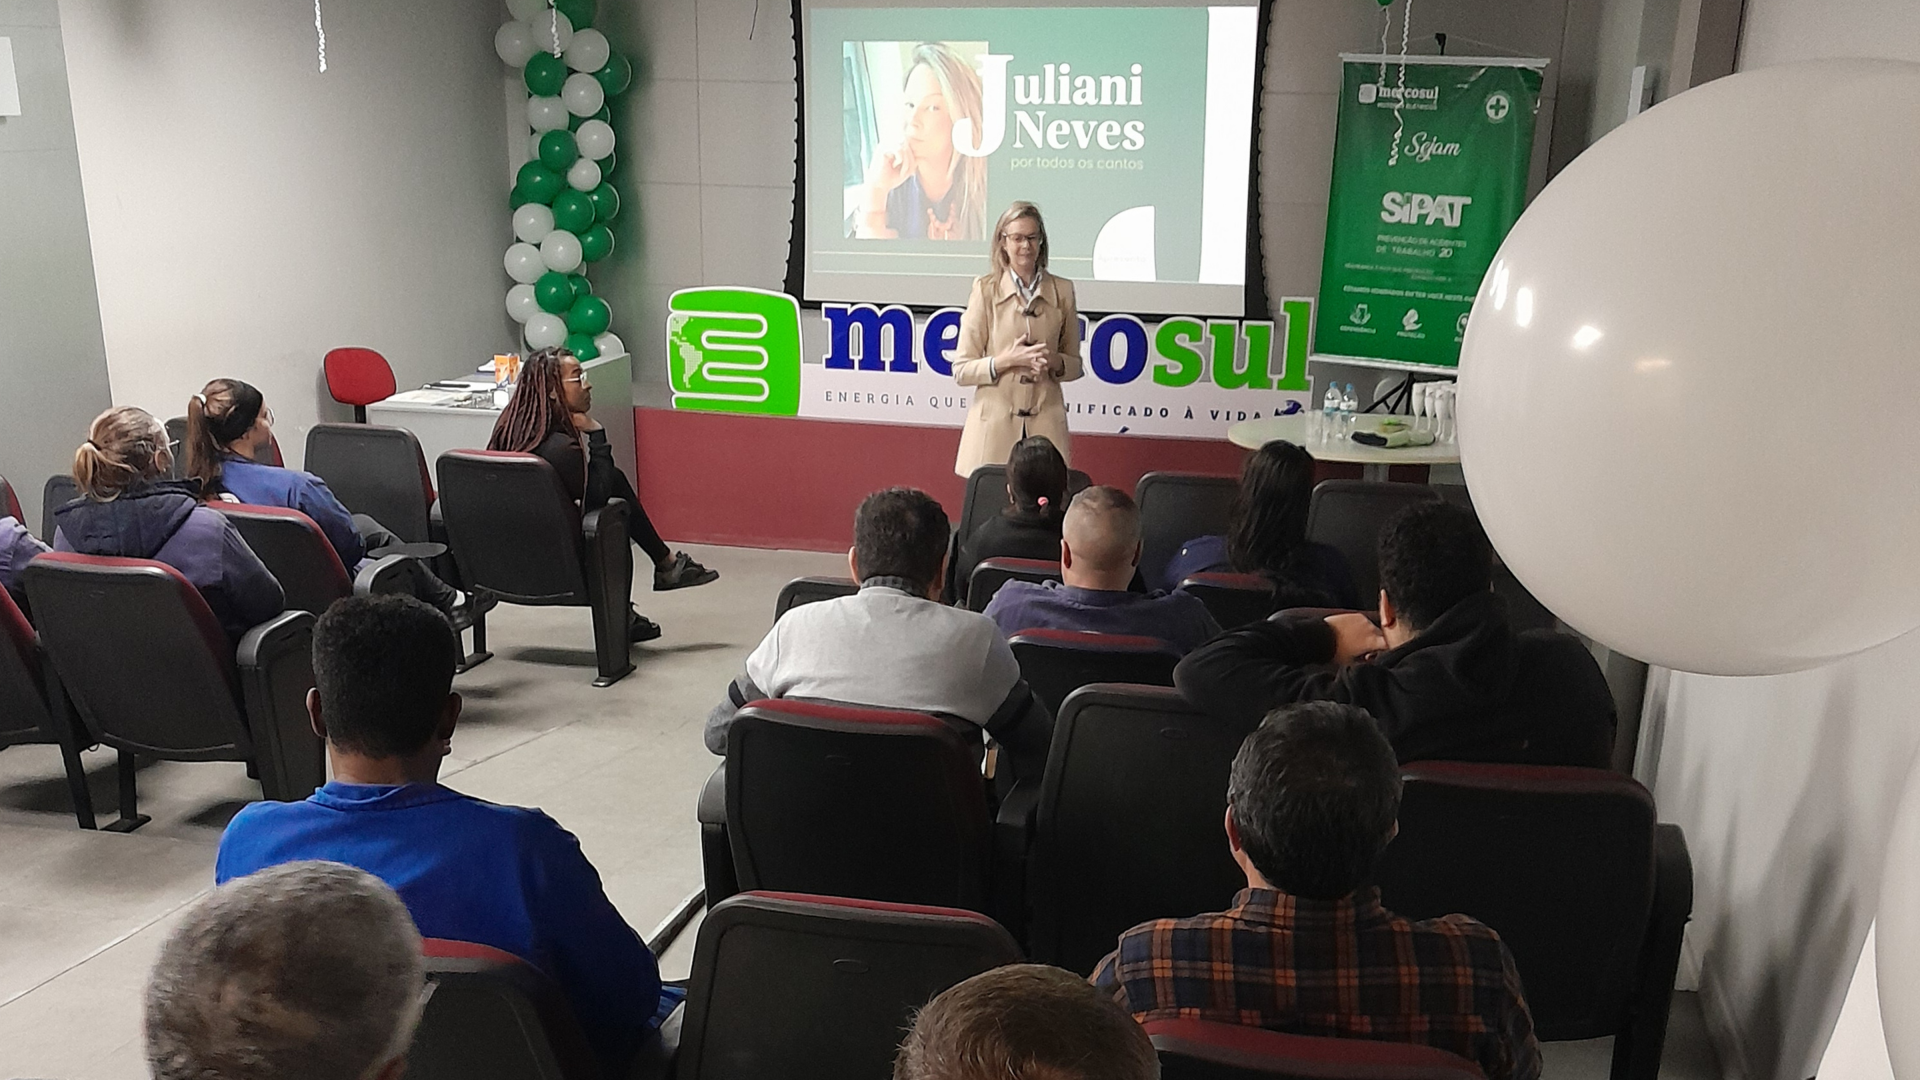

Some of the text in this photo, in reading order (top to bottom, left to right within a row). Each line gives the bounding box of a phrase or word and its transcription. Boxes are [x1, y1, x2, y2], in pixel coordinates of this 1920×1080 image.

[951, 54, 1144, 158] Juliani
[1378, 85, 1439, 99] mecosul
[1012, 110, 1145, 150] Neves
[1404, 131, 1461, 163] Sejam
[1011, 156, 1144, 171] por todos os cantos
[823, 300, 1312, 392] meosul
[825, 390, 915, 406] ENERGIA
[929, 396, 967, 409] QUE
[1066, 403, 1169, 418] IFICADO
[1184, 405, 1194, 419] À
